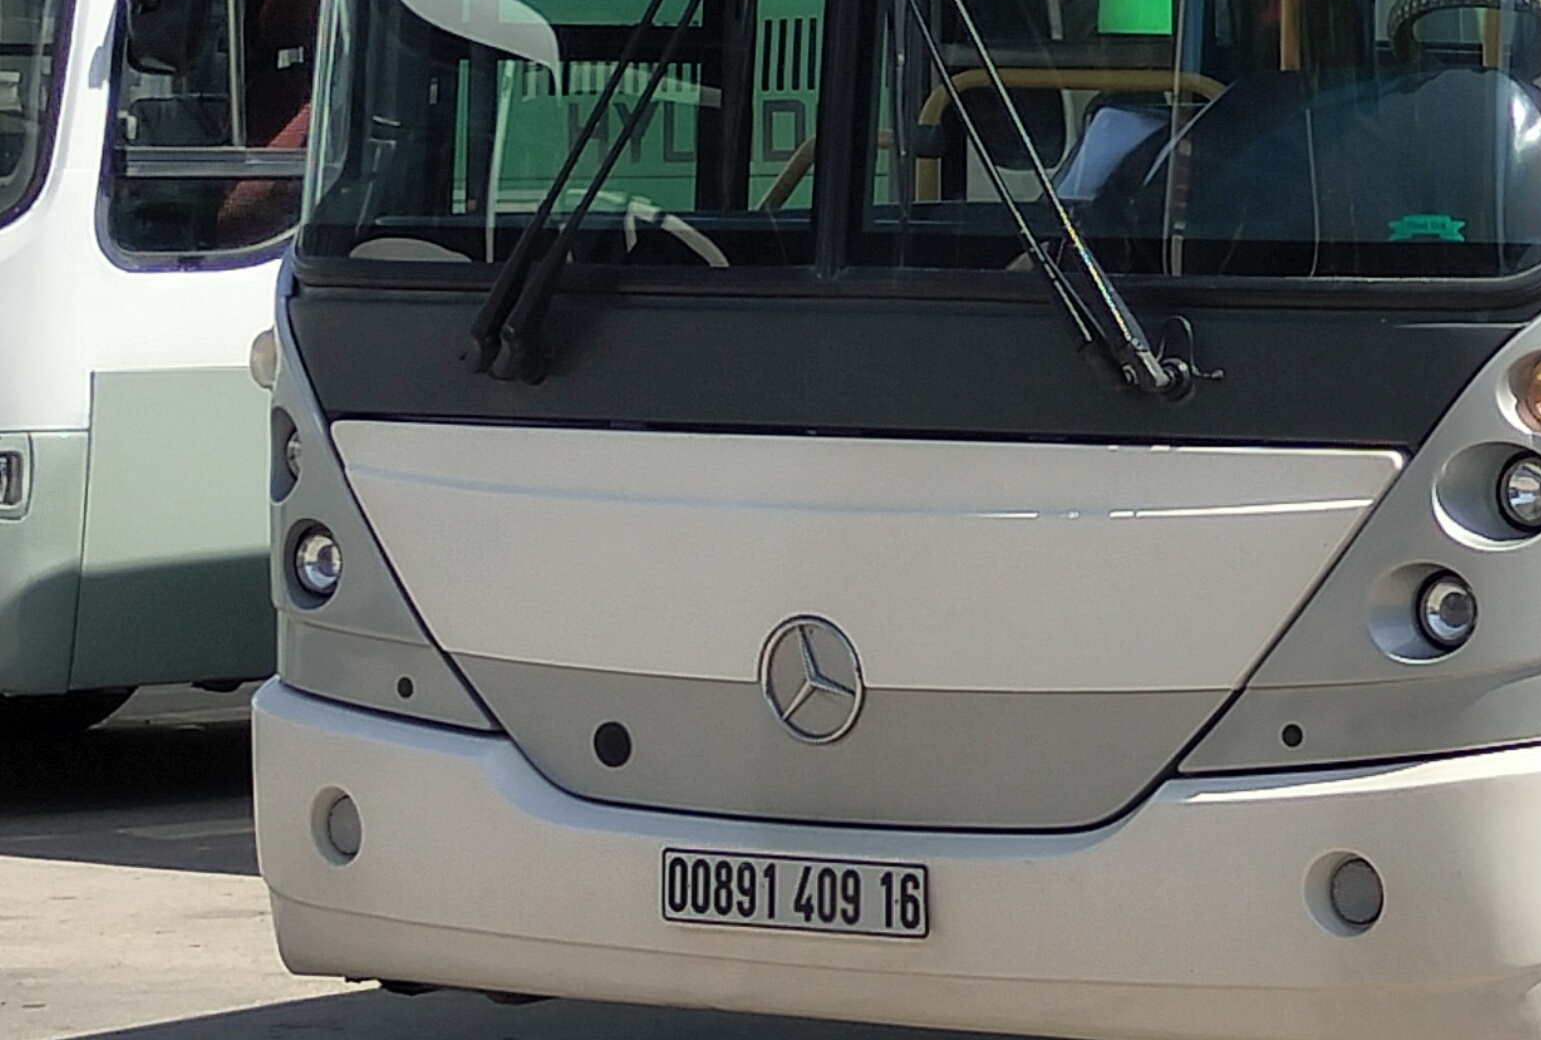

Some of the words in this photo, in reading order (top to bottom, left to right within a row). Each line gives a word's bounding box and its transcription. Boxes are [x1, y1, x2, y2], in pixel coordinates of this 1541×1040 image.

[668, 856, 776, 920] 00891
[793, 865, 862, 926] 409
[880, 871, 921, 930] 16
